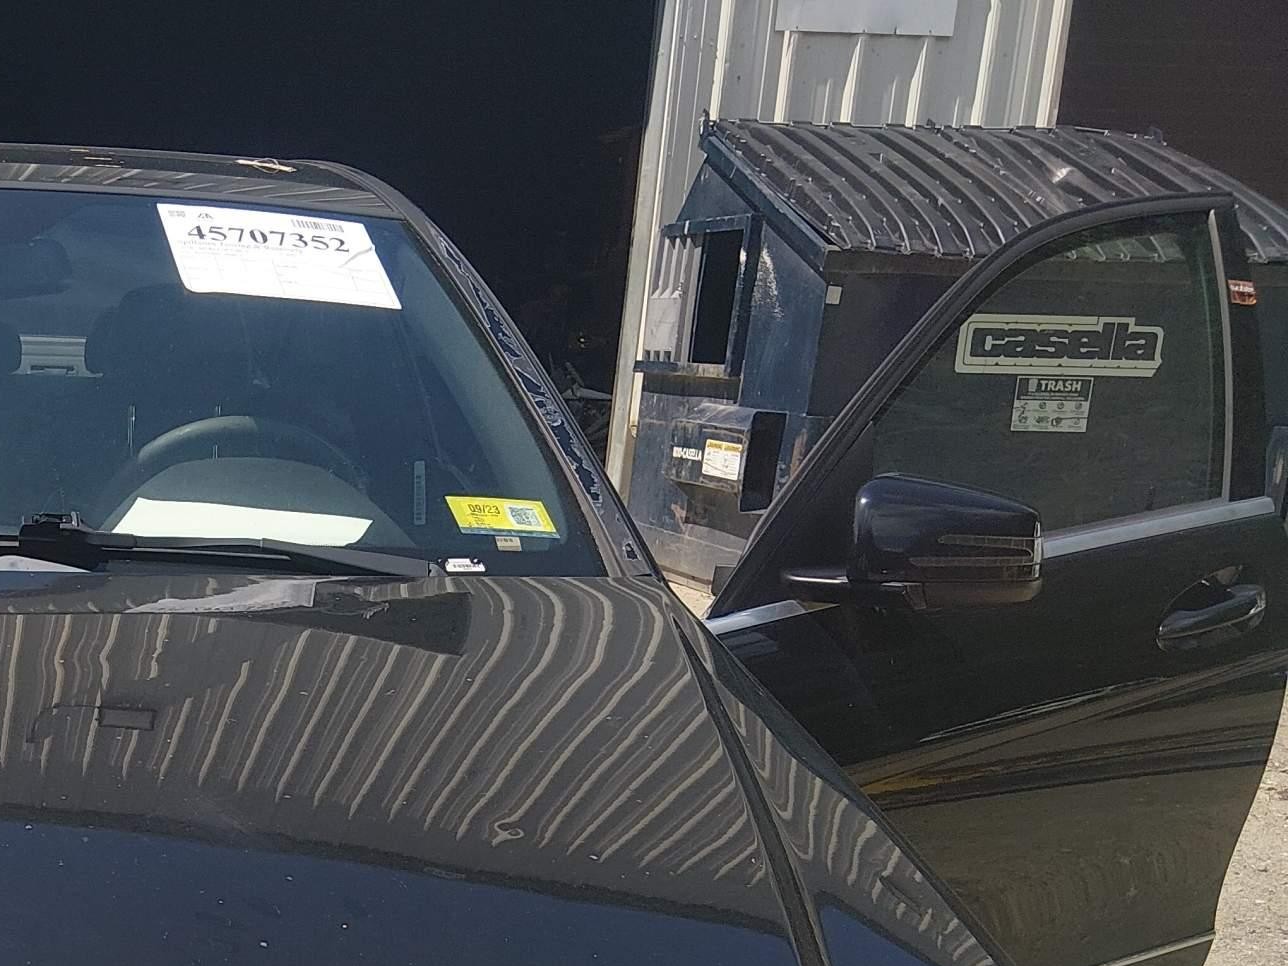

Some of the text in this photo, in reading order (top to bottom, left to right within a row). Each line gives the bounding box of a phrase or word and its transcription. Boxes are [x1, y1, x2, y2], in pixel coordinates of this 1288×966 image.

[187, 225, 350, 253] 45707352
[1039, 380, 1082, 392] TRASH
[467, 503, 501, 515] 09/23
